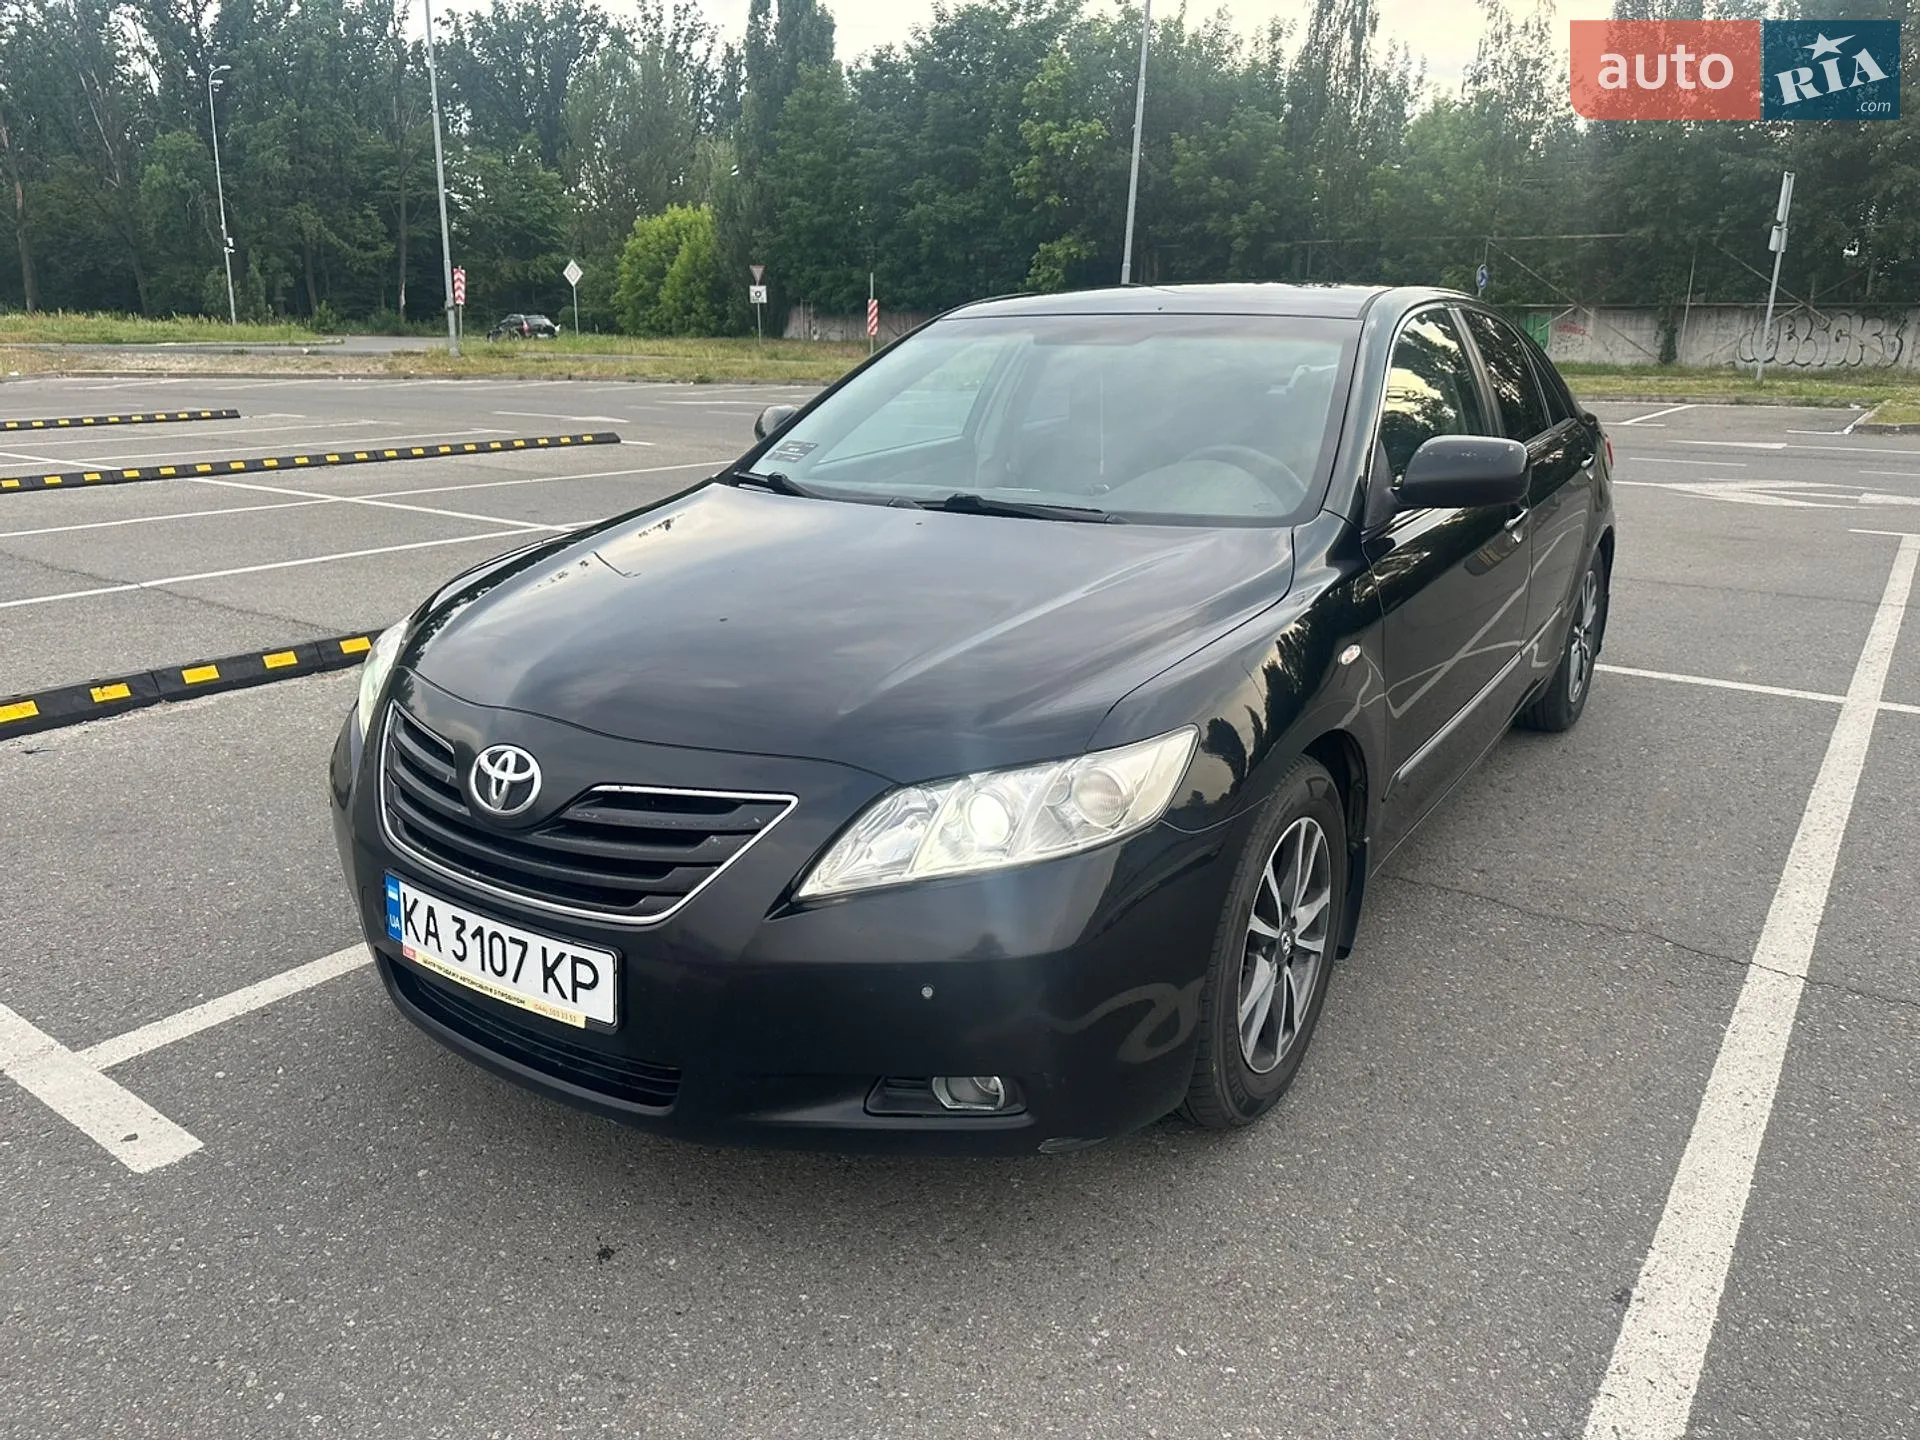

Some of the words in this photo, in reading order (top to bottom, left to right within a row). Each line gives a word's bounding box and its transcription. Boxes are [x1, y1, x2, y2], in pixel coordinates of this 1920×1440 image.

[389, 914, 401, 930] UA
[403, 891, 442, 953] KA
[452, 915, 528, 984] 3107
[541, 946, 599, 1003] KP
